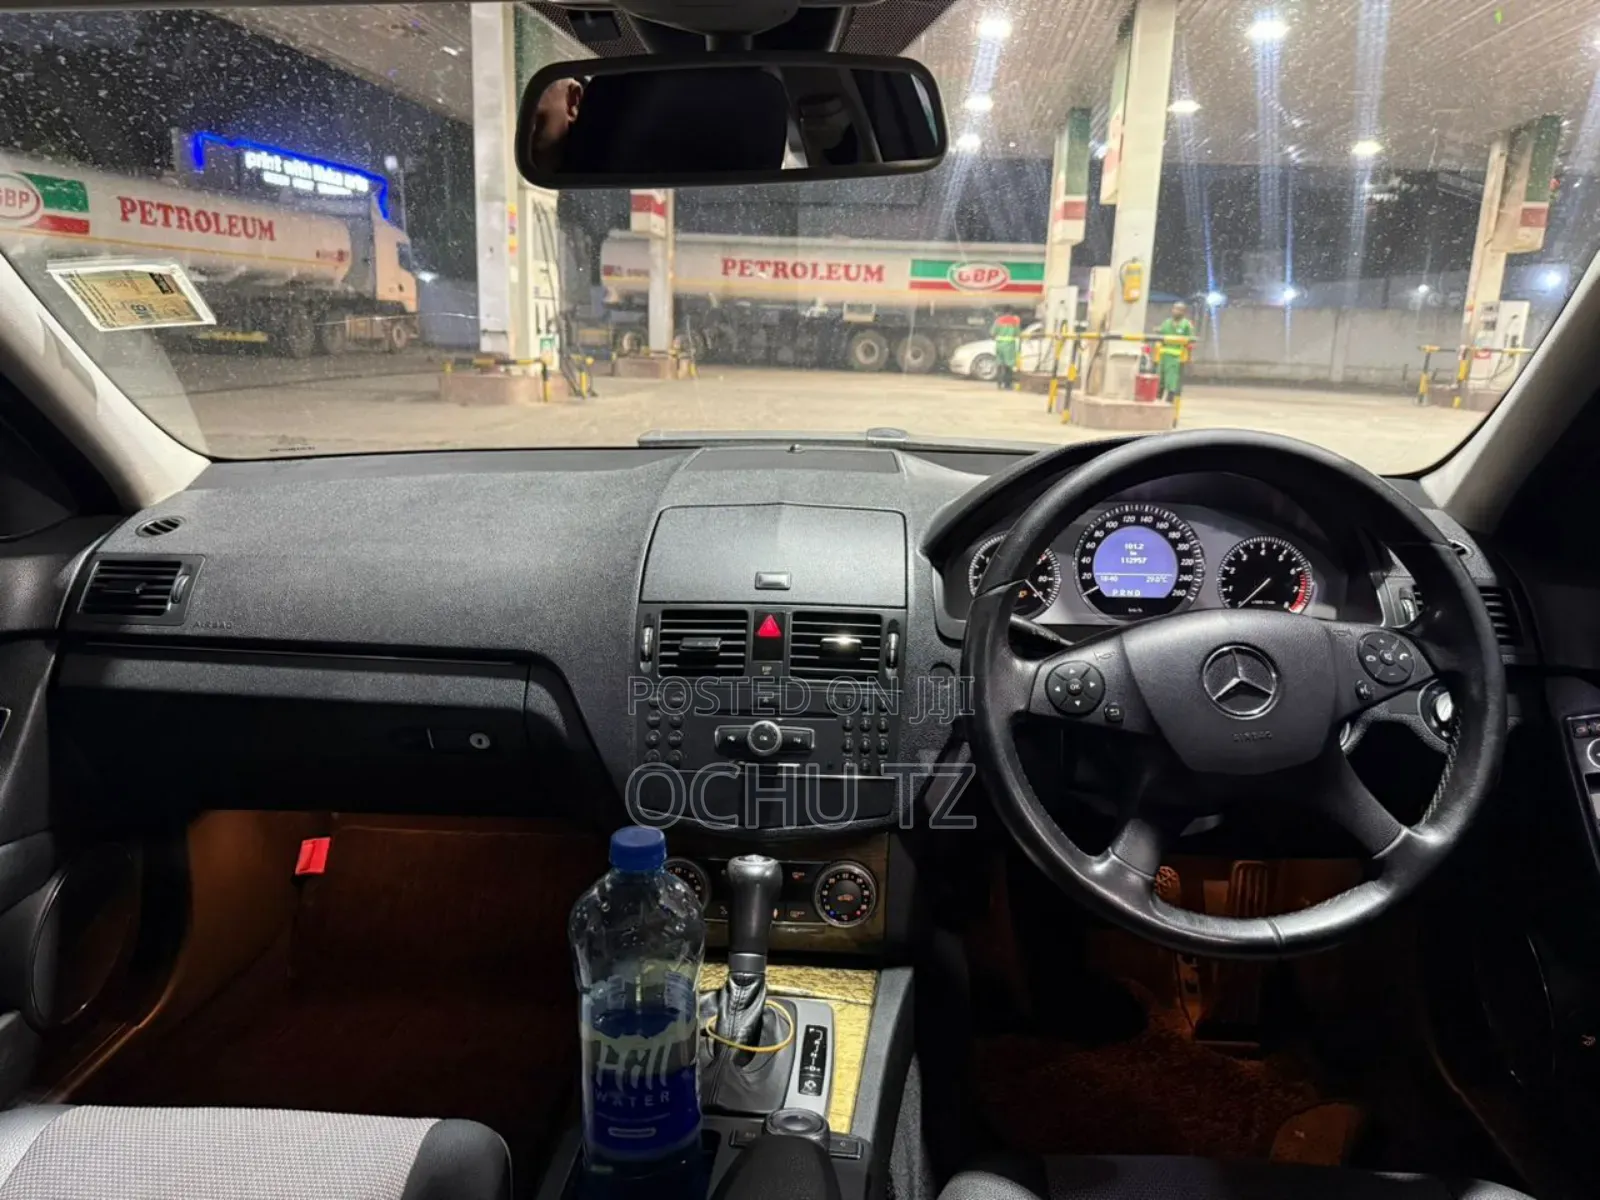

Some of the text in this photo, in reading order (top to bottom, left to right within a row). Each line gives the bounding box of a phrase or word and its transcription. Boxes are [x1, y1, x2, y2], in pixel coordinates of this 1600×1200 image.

[117, 196, 277, 241] PETROLEUM
[721, 258, 885, 283] PETROLEUM
[1140, 515, 1153, 523] 140
[1094, 530, 1105, 538] 80
[1168, 531, 1181, 539] 180
[1181, 558, 1194, 566] 220
[596, 1088, 670, 1108] WATER
